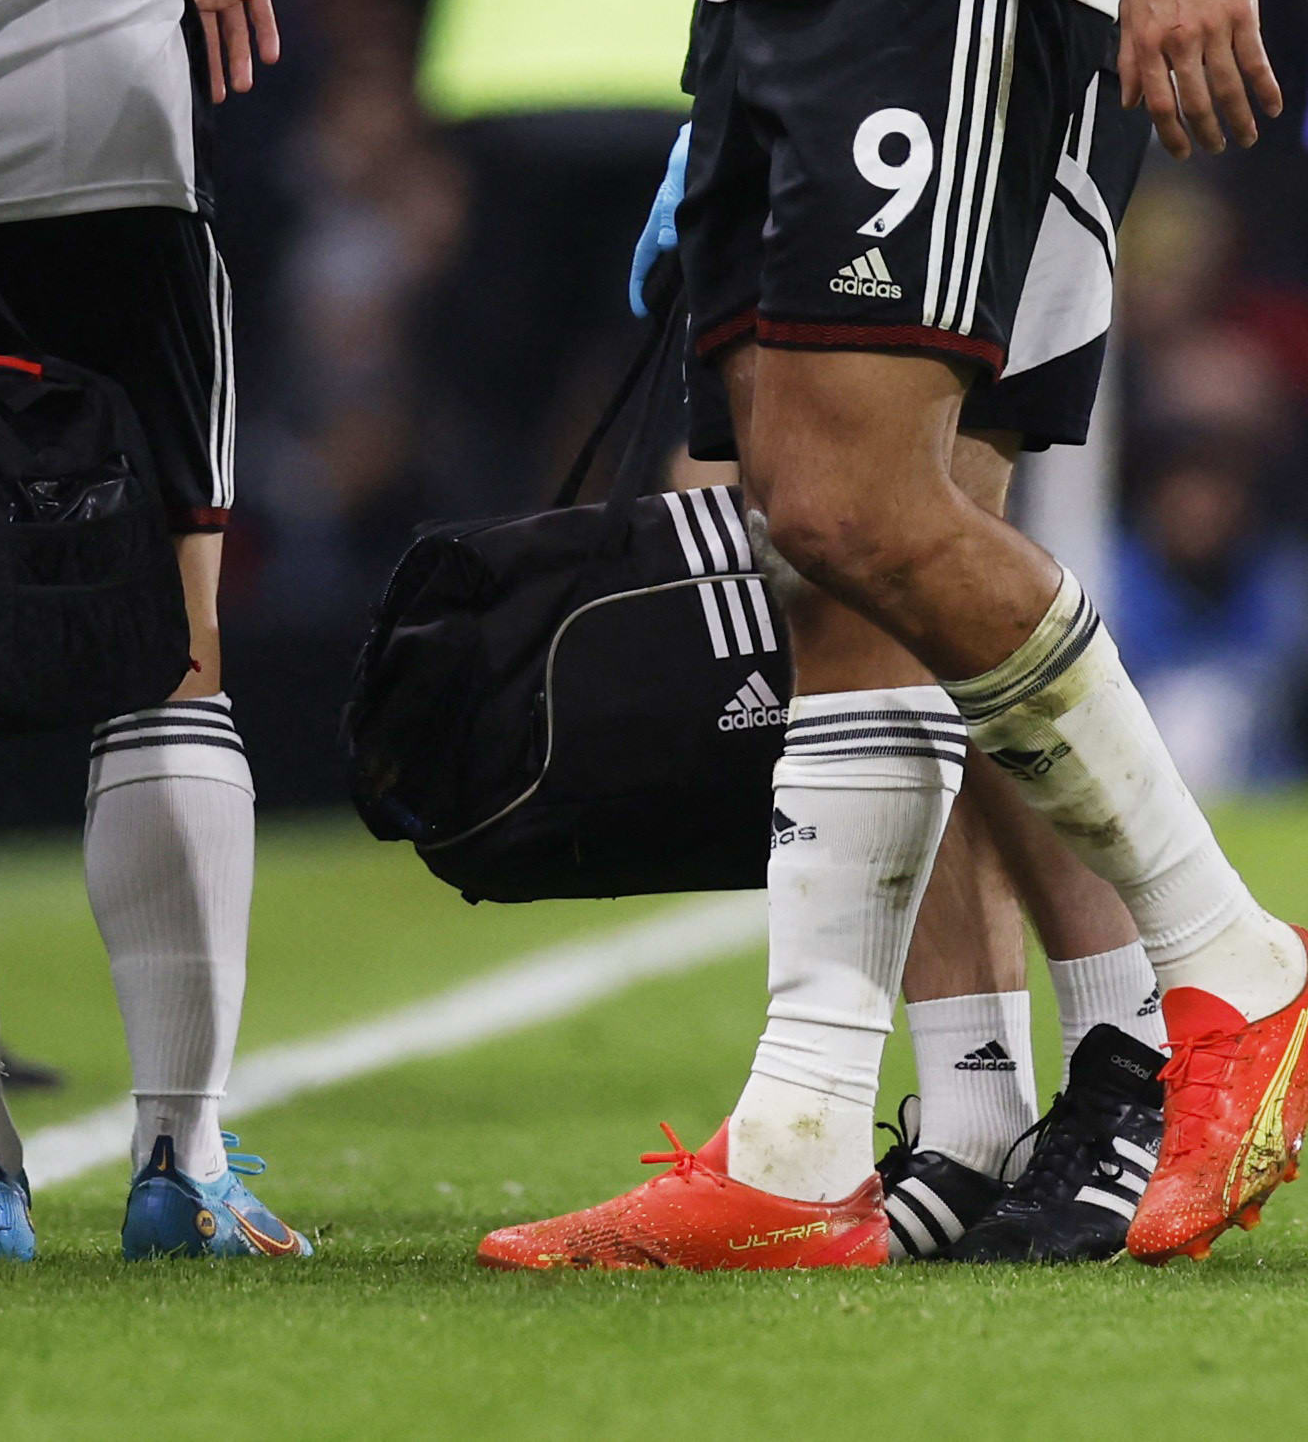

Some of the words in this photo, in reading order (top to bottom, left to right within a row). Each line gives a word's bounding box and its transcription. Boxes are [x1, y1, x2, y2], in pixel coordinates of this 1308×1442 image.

[852, 107, 934, 239] 9
[829, 276, 903, 300] adidas
[717, 706, 790, 732] adidas
[954, 1058, 1017, 1071] adidas
[729, 1221, 828, 1250] ULTRA
